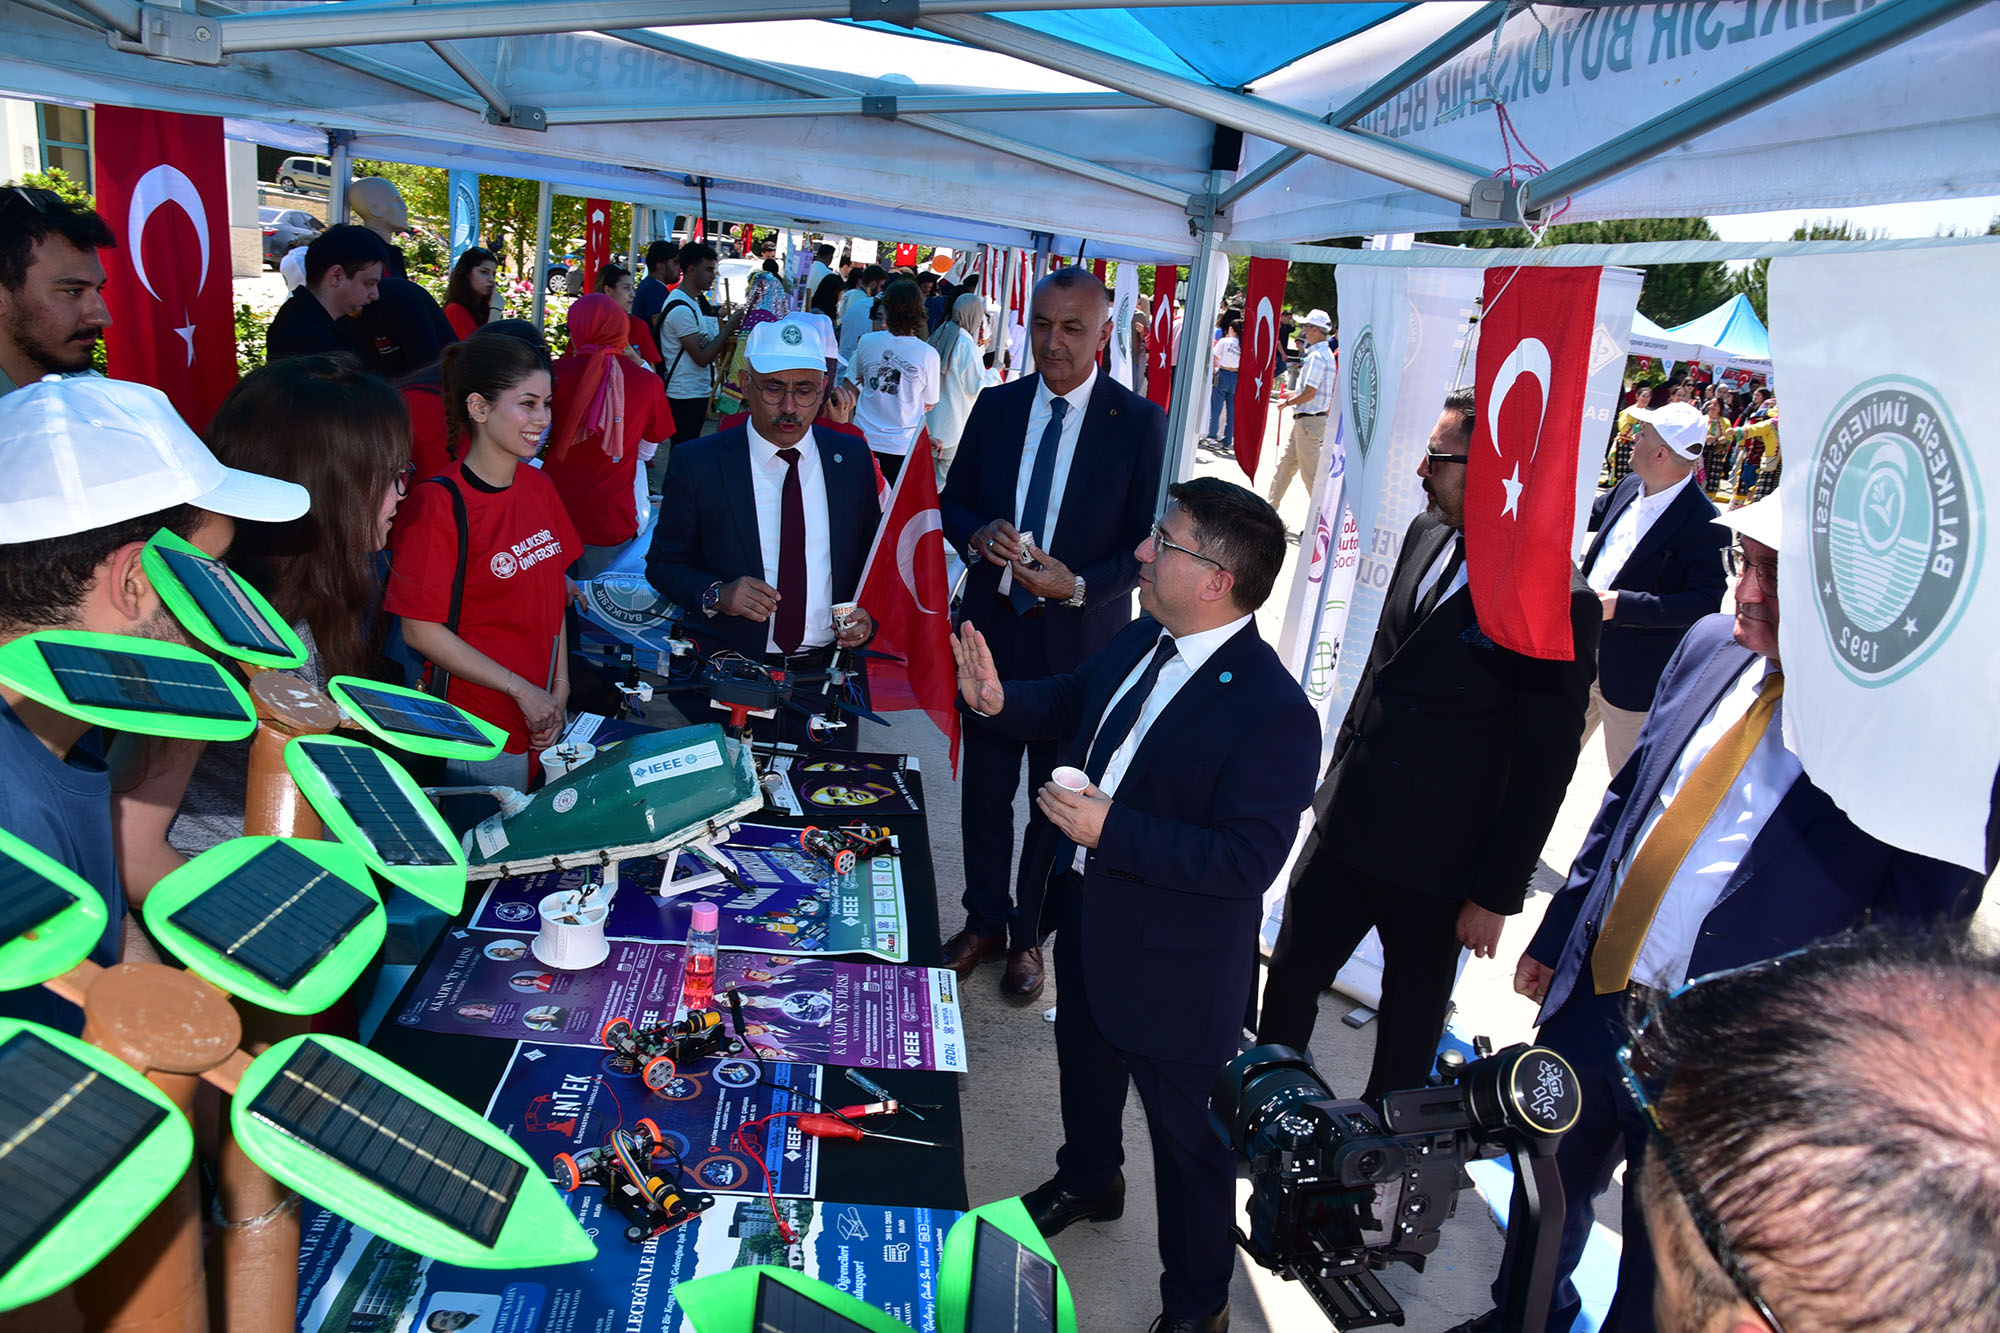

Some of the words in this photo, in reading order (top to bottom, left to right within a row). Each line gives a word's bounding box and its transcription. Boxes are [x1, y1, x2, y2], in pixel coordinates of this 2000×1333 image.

[511, 529, 554, 557] BALIKESİR
[596, 589, 643, 622] BALIKESİR
[648, 757, 683, 775] IEEE
[842, 896, 858, 916] IEEE
[836, 973, 849, 998] DERSE
[639, 1010, 659, 1030] EEE
[834, 1016, 848, 1045] KADIN
[903, 1031, 920, 1056] IEEE
[786, 1126, 801, 1150] IEEE
[642, 1237, 658, 1254] Bİ
[834, 1245, 851, 1291] Öğrencileri
[852, 1260, 867, 1301] uluşuyor!
[920, 1269, 931, 1279] Sen
